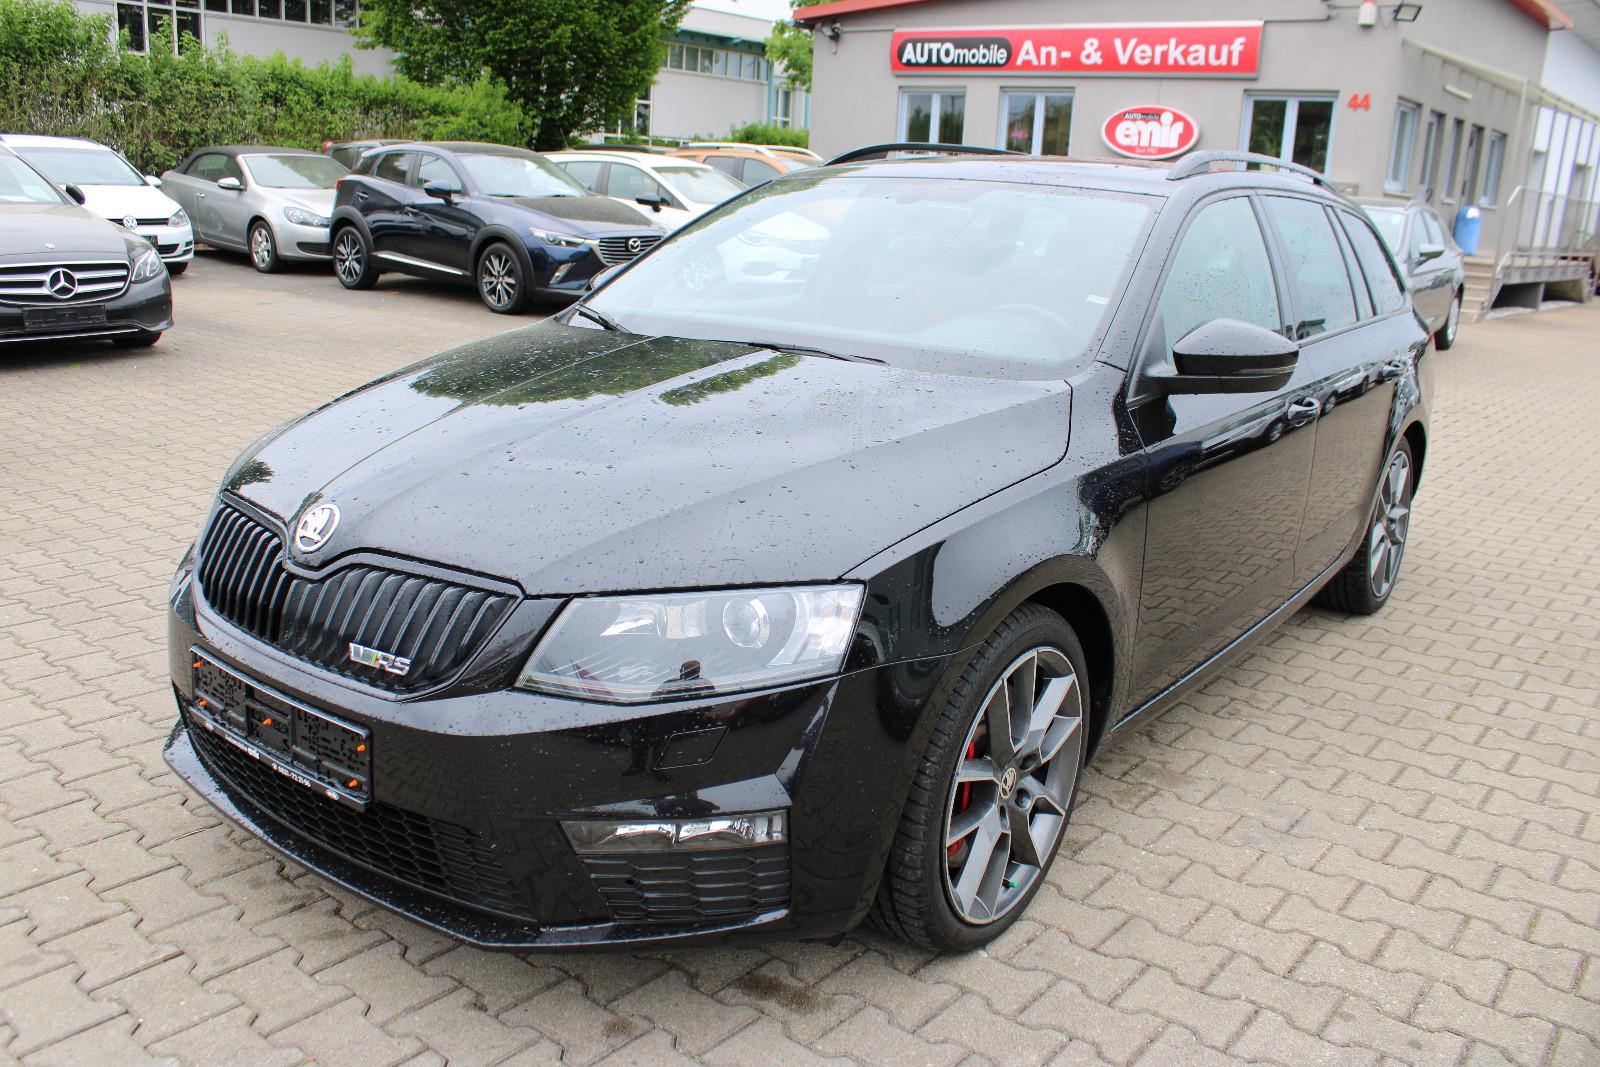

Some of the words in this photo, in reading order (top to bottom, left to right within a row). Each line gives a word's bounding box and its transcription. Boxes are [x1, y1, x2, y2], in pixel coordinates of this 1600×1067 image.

[902, 42, 1007, 64] AUTOmobile
[1016, 40, 1071, 66] An-
[1080, 38, 1103, 65] &
[1114, 37, 1246, 66] Verkauf
[1347, 93, 1371, 111] 44
[1115, 111, 1184, 148] emir
